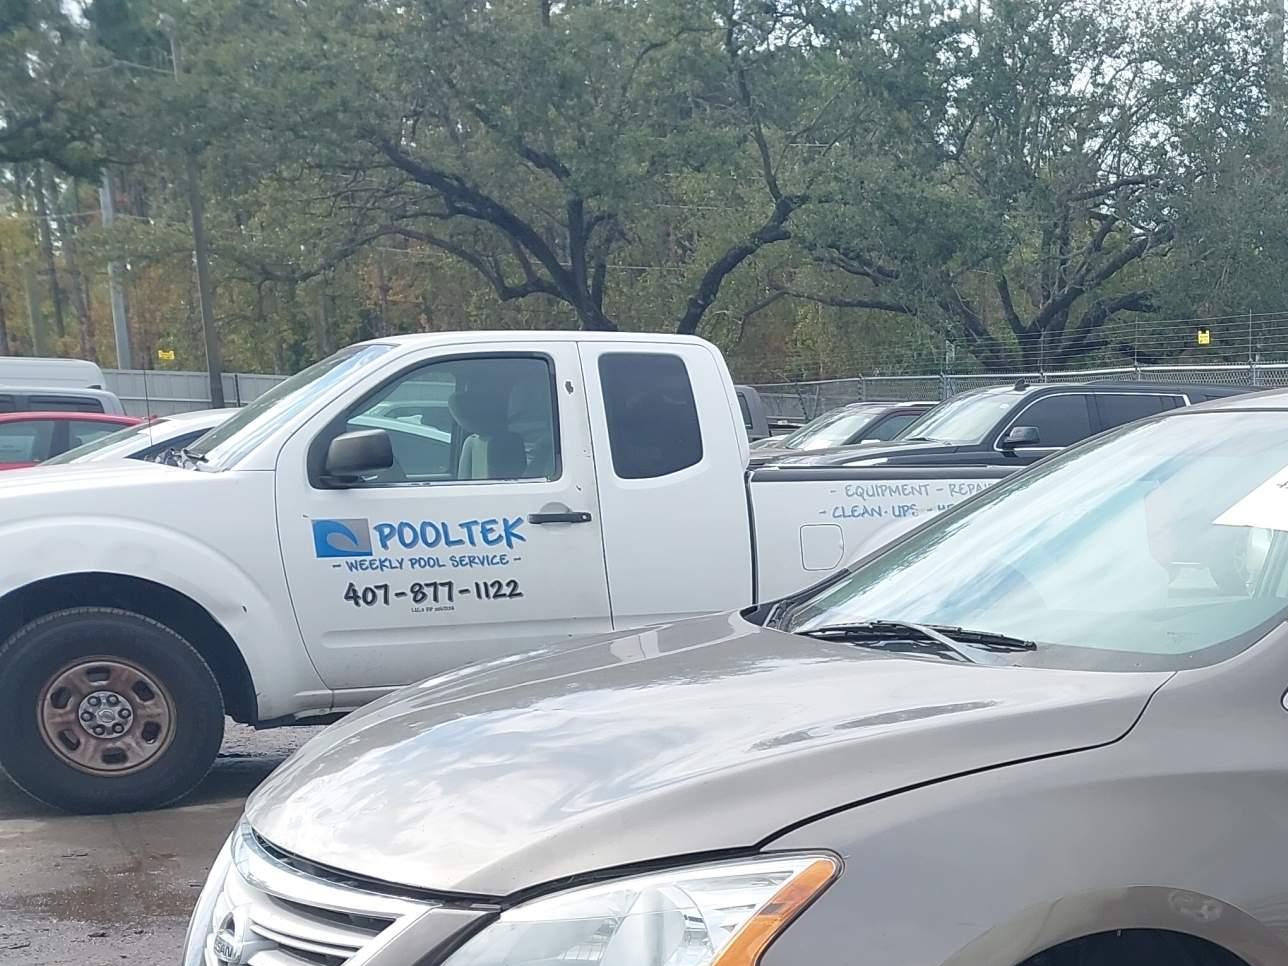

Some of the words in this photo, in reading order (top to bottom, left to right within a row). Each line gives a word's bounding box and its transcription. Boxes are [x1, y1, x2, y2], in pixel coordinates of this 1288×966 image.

[845, 483, 930, 501] EQUIPMENT
[373, 517, 526, 550] POOLTEK
[345, 557, 404, 573] WEEKLY
[409, 556, 447, 570] POOL
[449, 553, 509, 568] SERVICE
[343, 579, 524, 607] 407-877-1122
